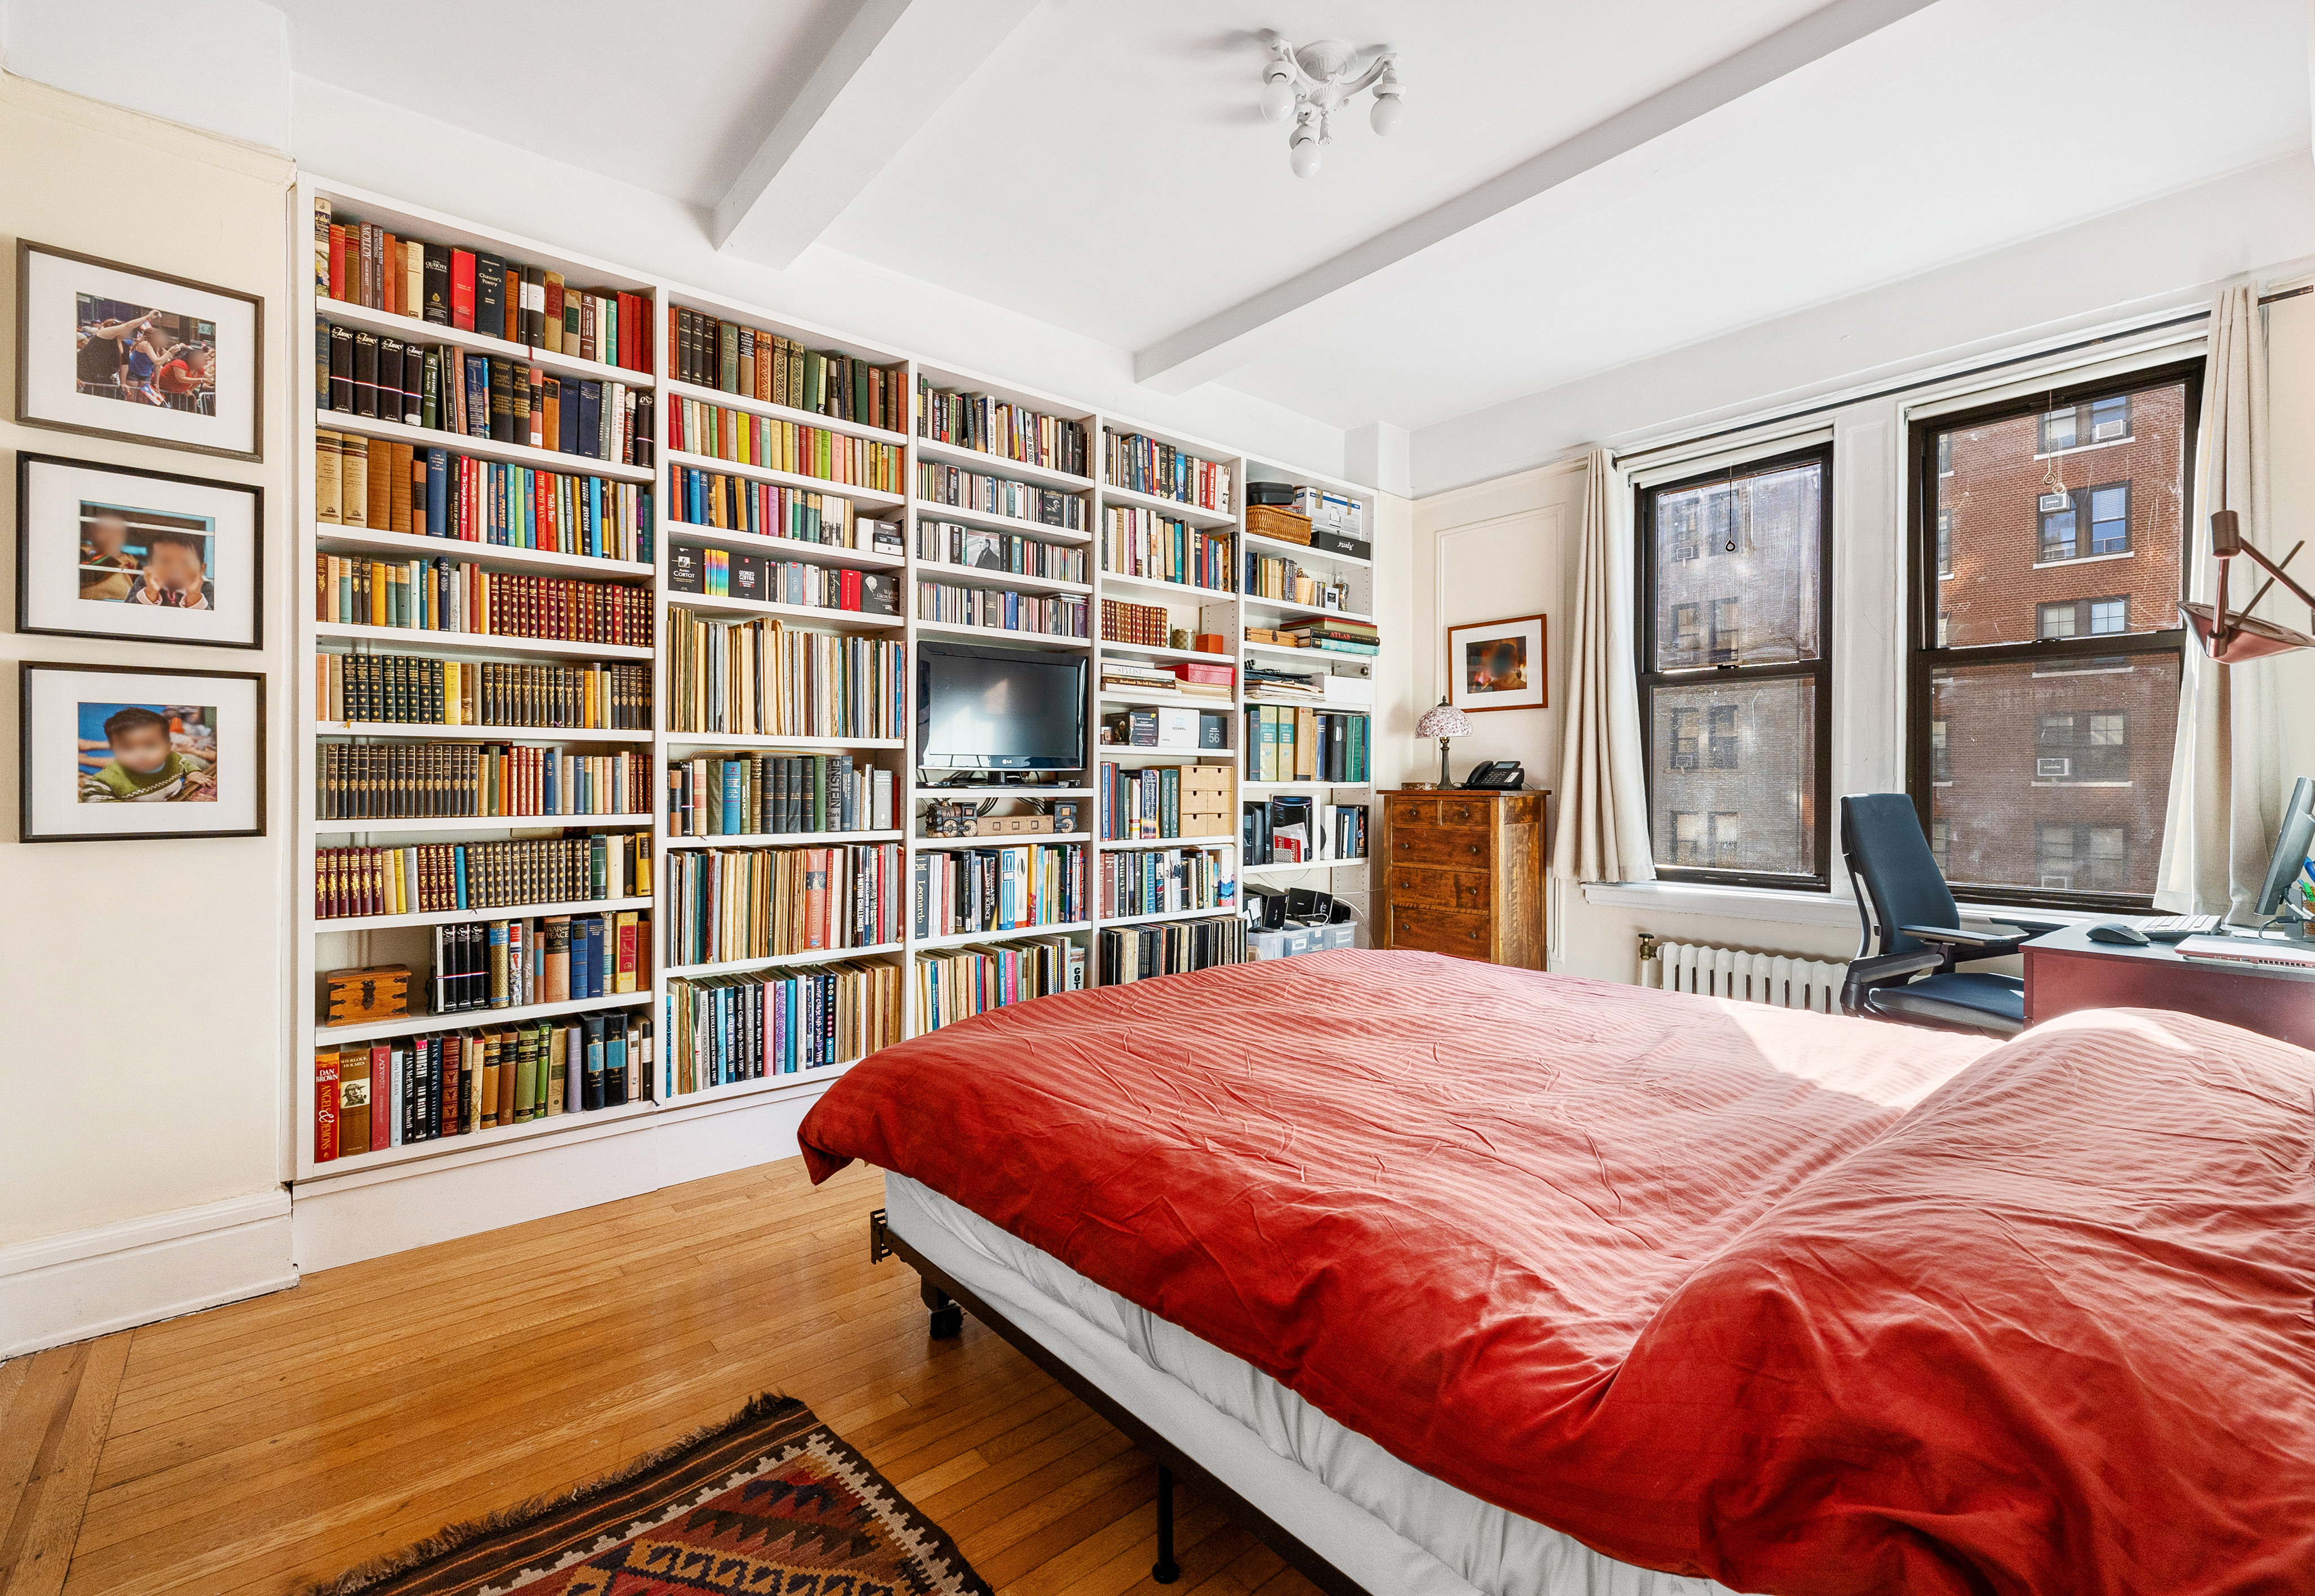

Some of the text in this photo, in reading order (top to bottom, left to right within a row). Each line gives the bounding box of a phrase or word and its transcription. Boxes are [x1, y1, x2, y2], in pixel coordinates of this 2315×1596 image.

[362, 226, 372, 260] MOLLOY
[426, 261, 448, 270] QUIJOTE
[479, 272, 502, 283] Chaucer's
[482, 278, 498, 287] Poetry
[546, 493, 555, 509] Teddy
[1337, 542, 1355, 551] Aperta
[1208, 733, 1220, 743] 56
[830, 758, 841, 808] EINSTEIN
[917, 880, 926, 923] Leonardo
[523, 963, 531, 978] Dylan
[416, 1048, 427, 1078] INNOCENT
[316, 1074, 338, 1083] BROWN
[417, 1086, 426, 1120] IAN McEWAN
[319, 1085, 334, 1150] ANGELS & DEMONS
